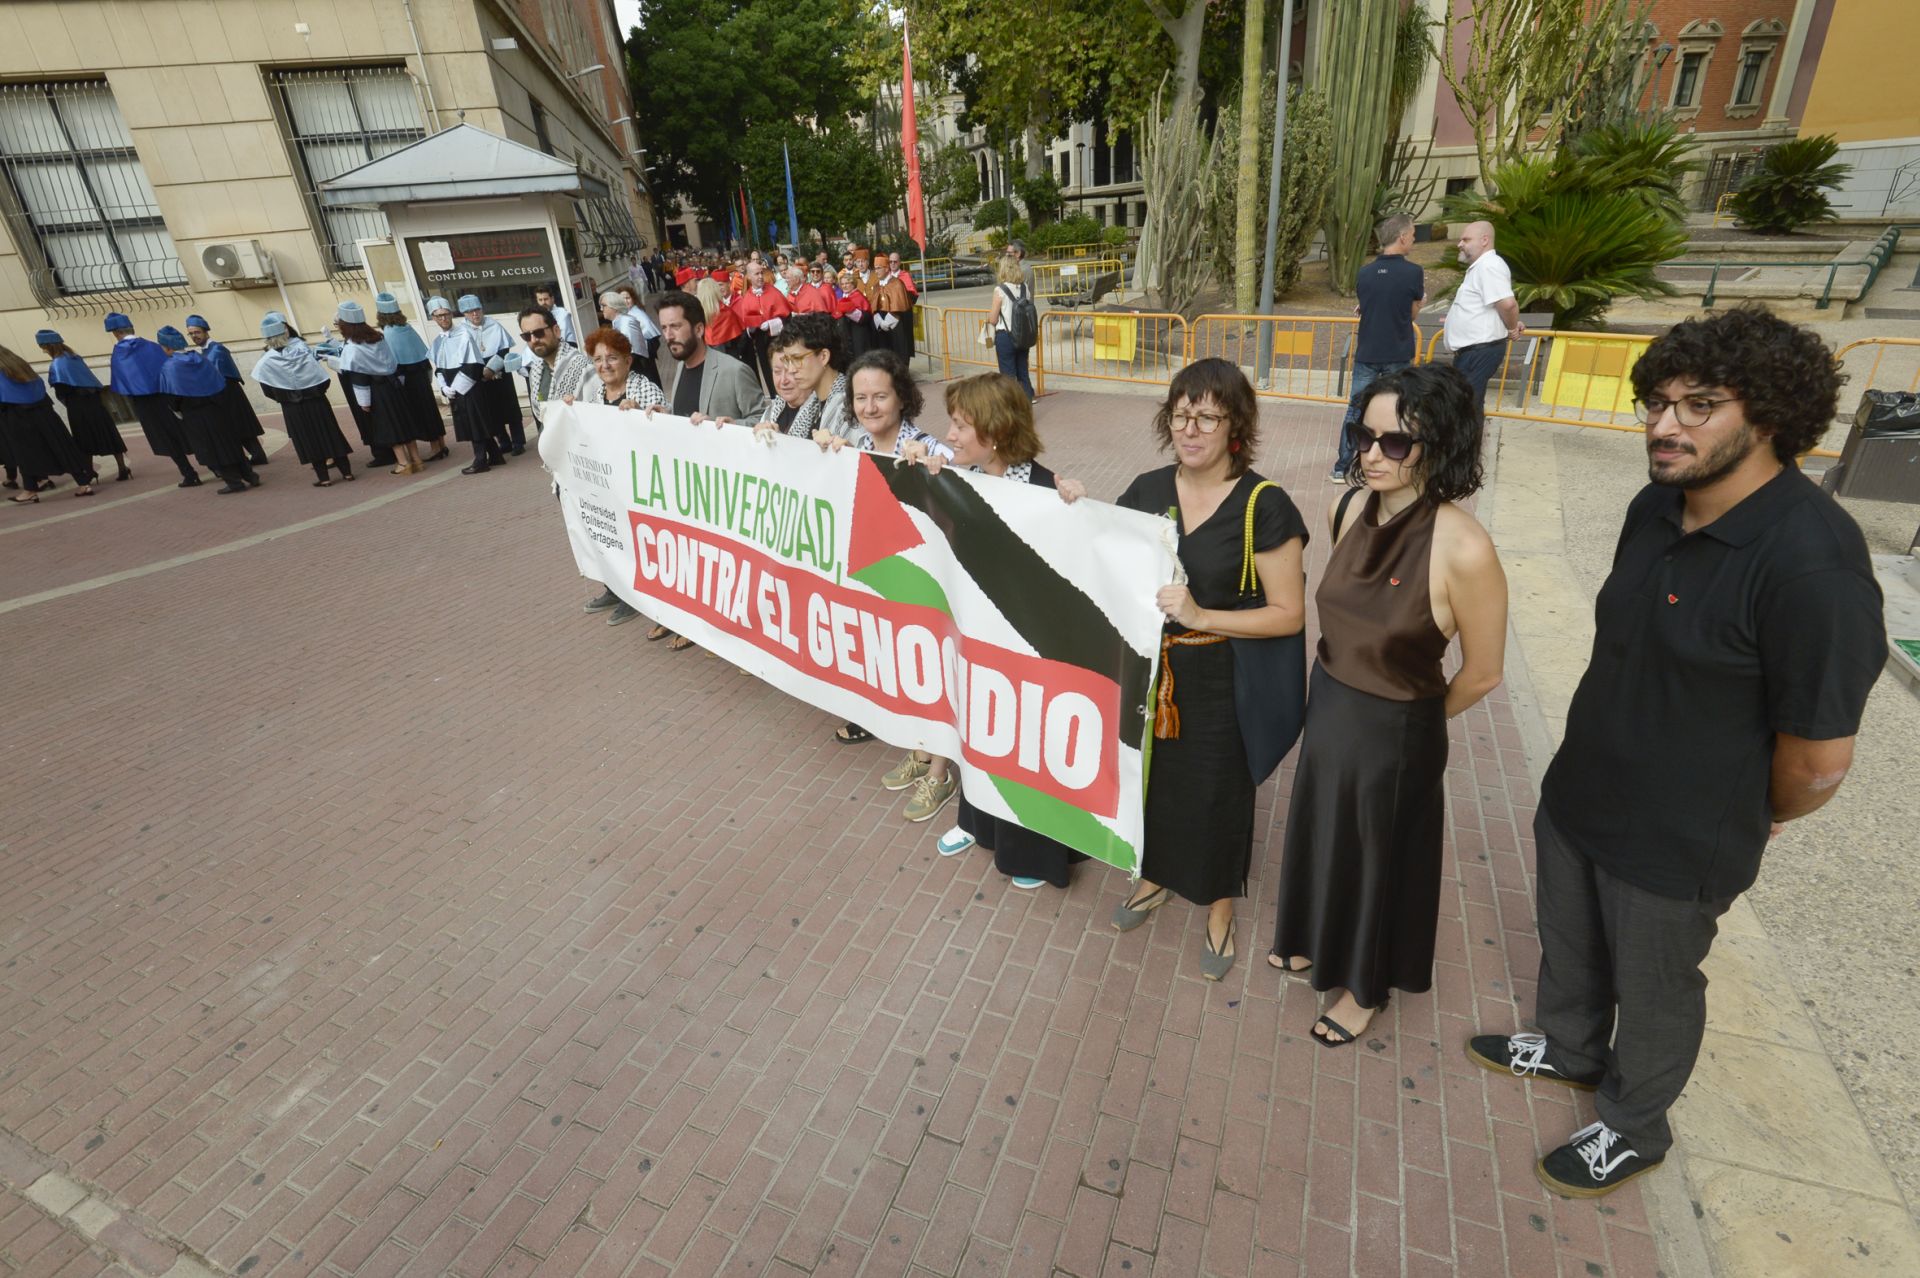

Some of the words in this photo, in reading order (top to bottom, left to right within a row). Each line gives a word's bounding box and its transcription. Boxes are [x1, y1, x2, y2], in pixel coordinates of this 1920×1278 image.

[427, 271, 478, 282] CONTROL
[482, 270, 496, 278] DE
[501, 266, 545, 277] ACCESOS
[579, 496, 617, 522] Universidad
[631, 450, 667, 512] LA
[674, 457, 842, 586] UNIVERSIDAD,
[588, 527, 624, 551] Cartagena
[636, 522, 752, 629] CONTRA
[757, 570, 799, 654] EL
